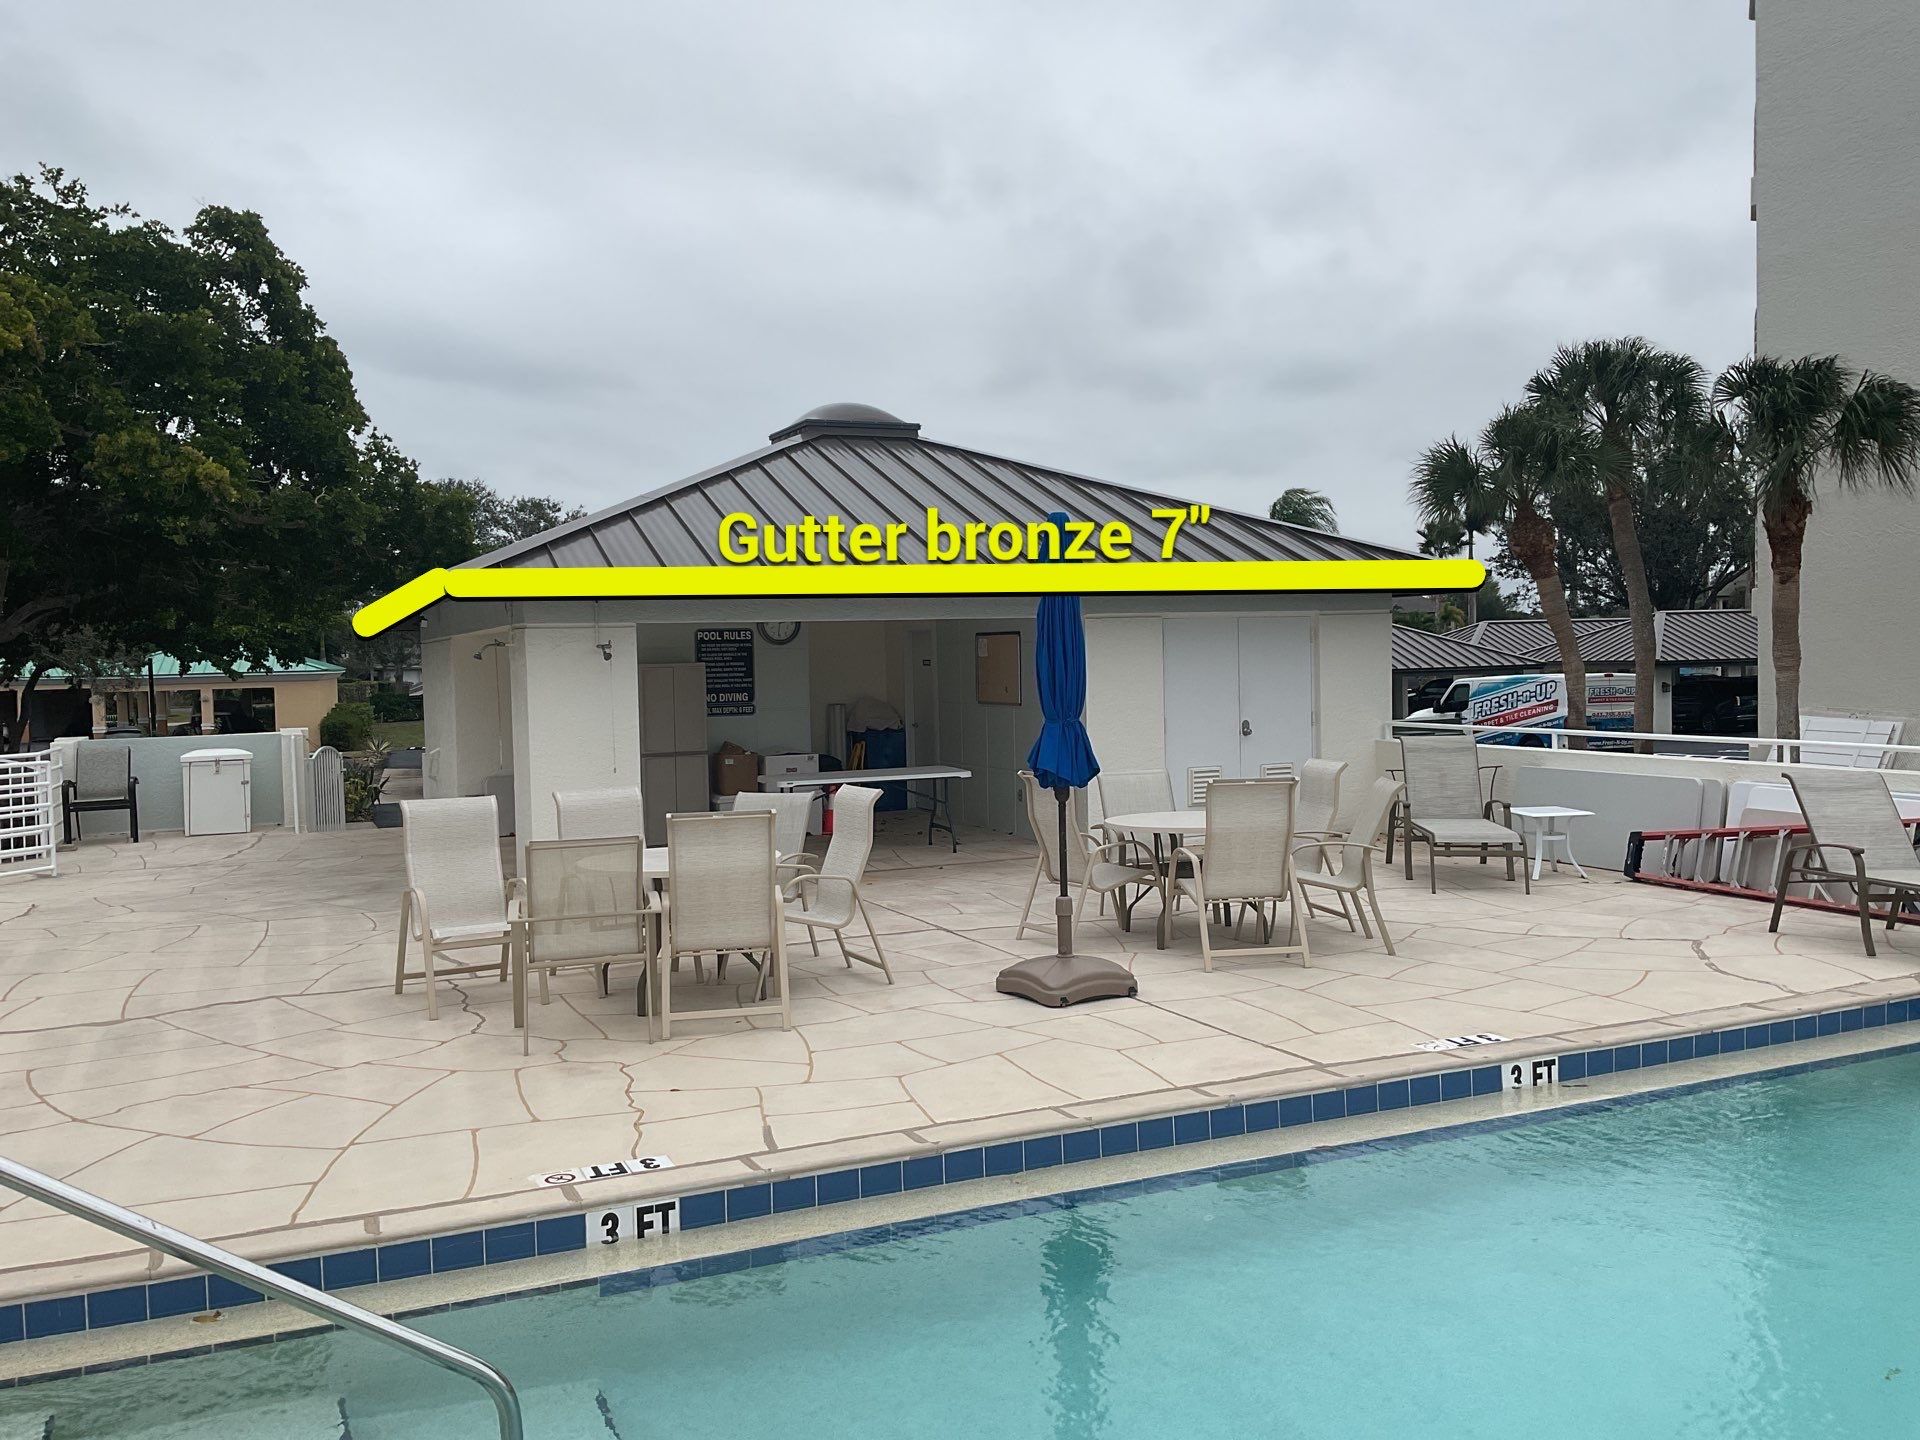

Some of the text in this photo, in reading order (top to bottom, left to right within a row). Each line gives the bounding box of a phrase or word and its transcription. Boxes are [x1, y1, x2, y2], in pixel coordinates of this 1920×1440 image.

[697, 631, 752, 640] POOL RULES
[706, 692, 749, 703] NO DIVING
[1473, 679, 1557, 718] FRESH-n-UP
[1476, 718, 1499, 727] ARPET
[1505, 713, 1519, 722] TILE
[1519, 704, 1554, 718] CLEANING
[1445, 1037, 1481, 1046] FT
[1510, 1058, 1556, 1089] 3 FT
[589, 1162, 629, 1179] FT
[639, 1157, 661, 1170] 3
[600, 1201, 676, 1245] 3 FT
